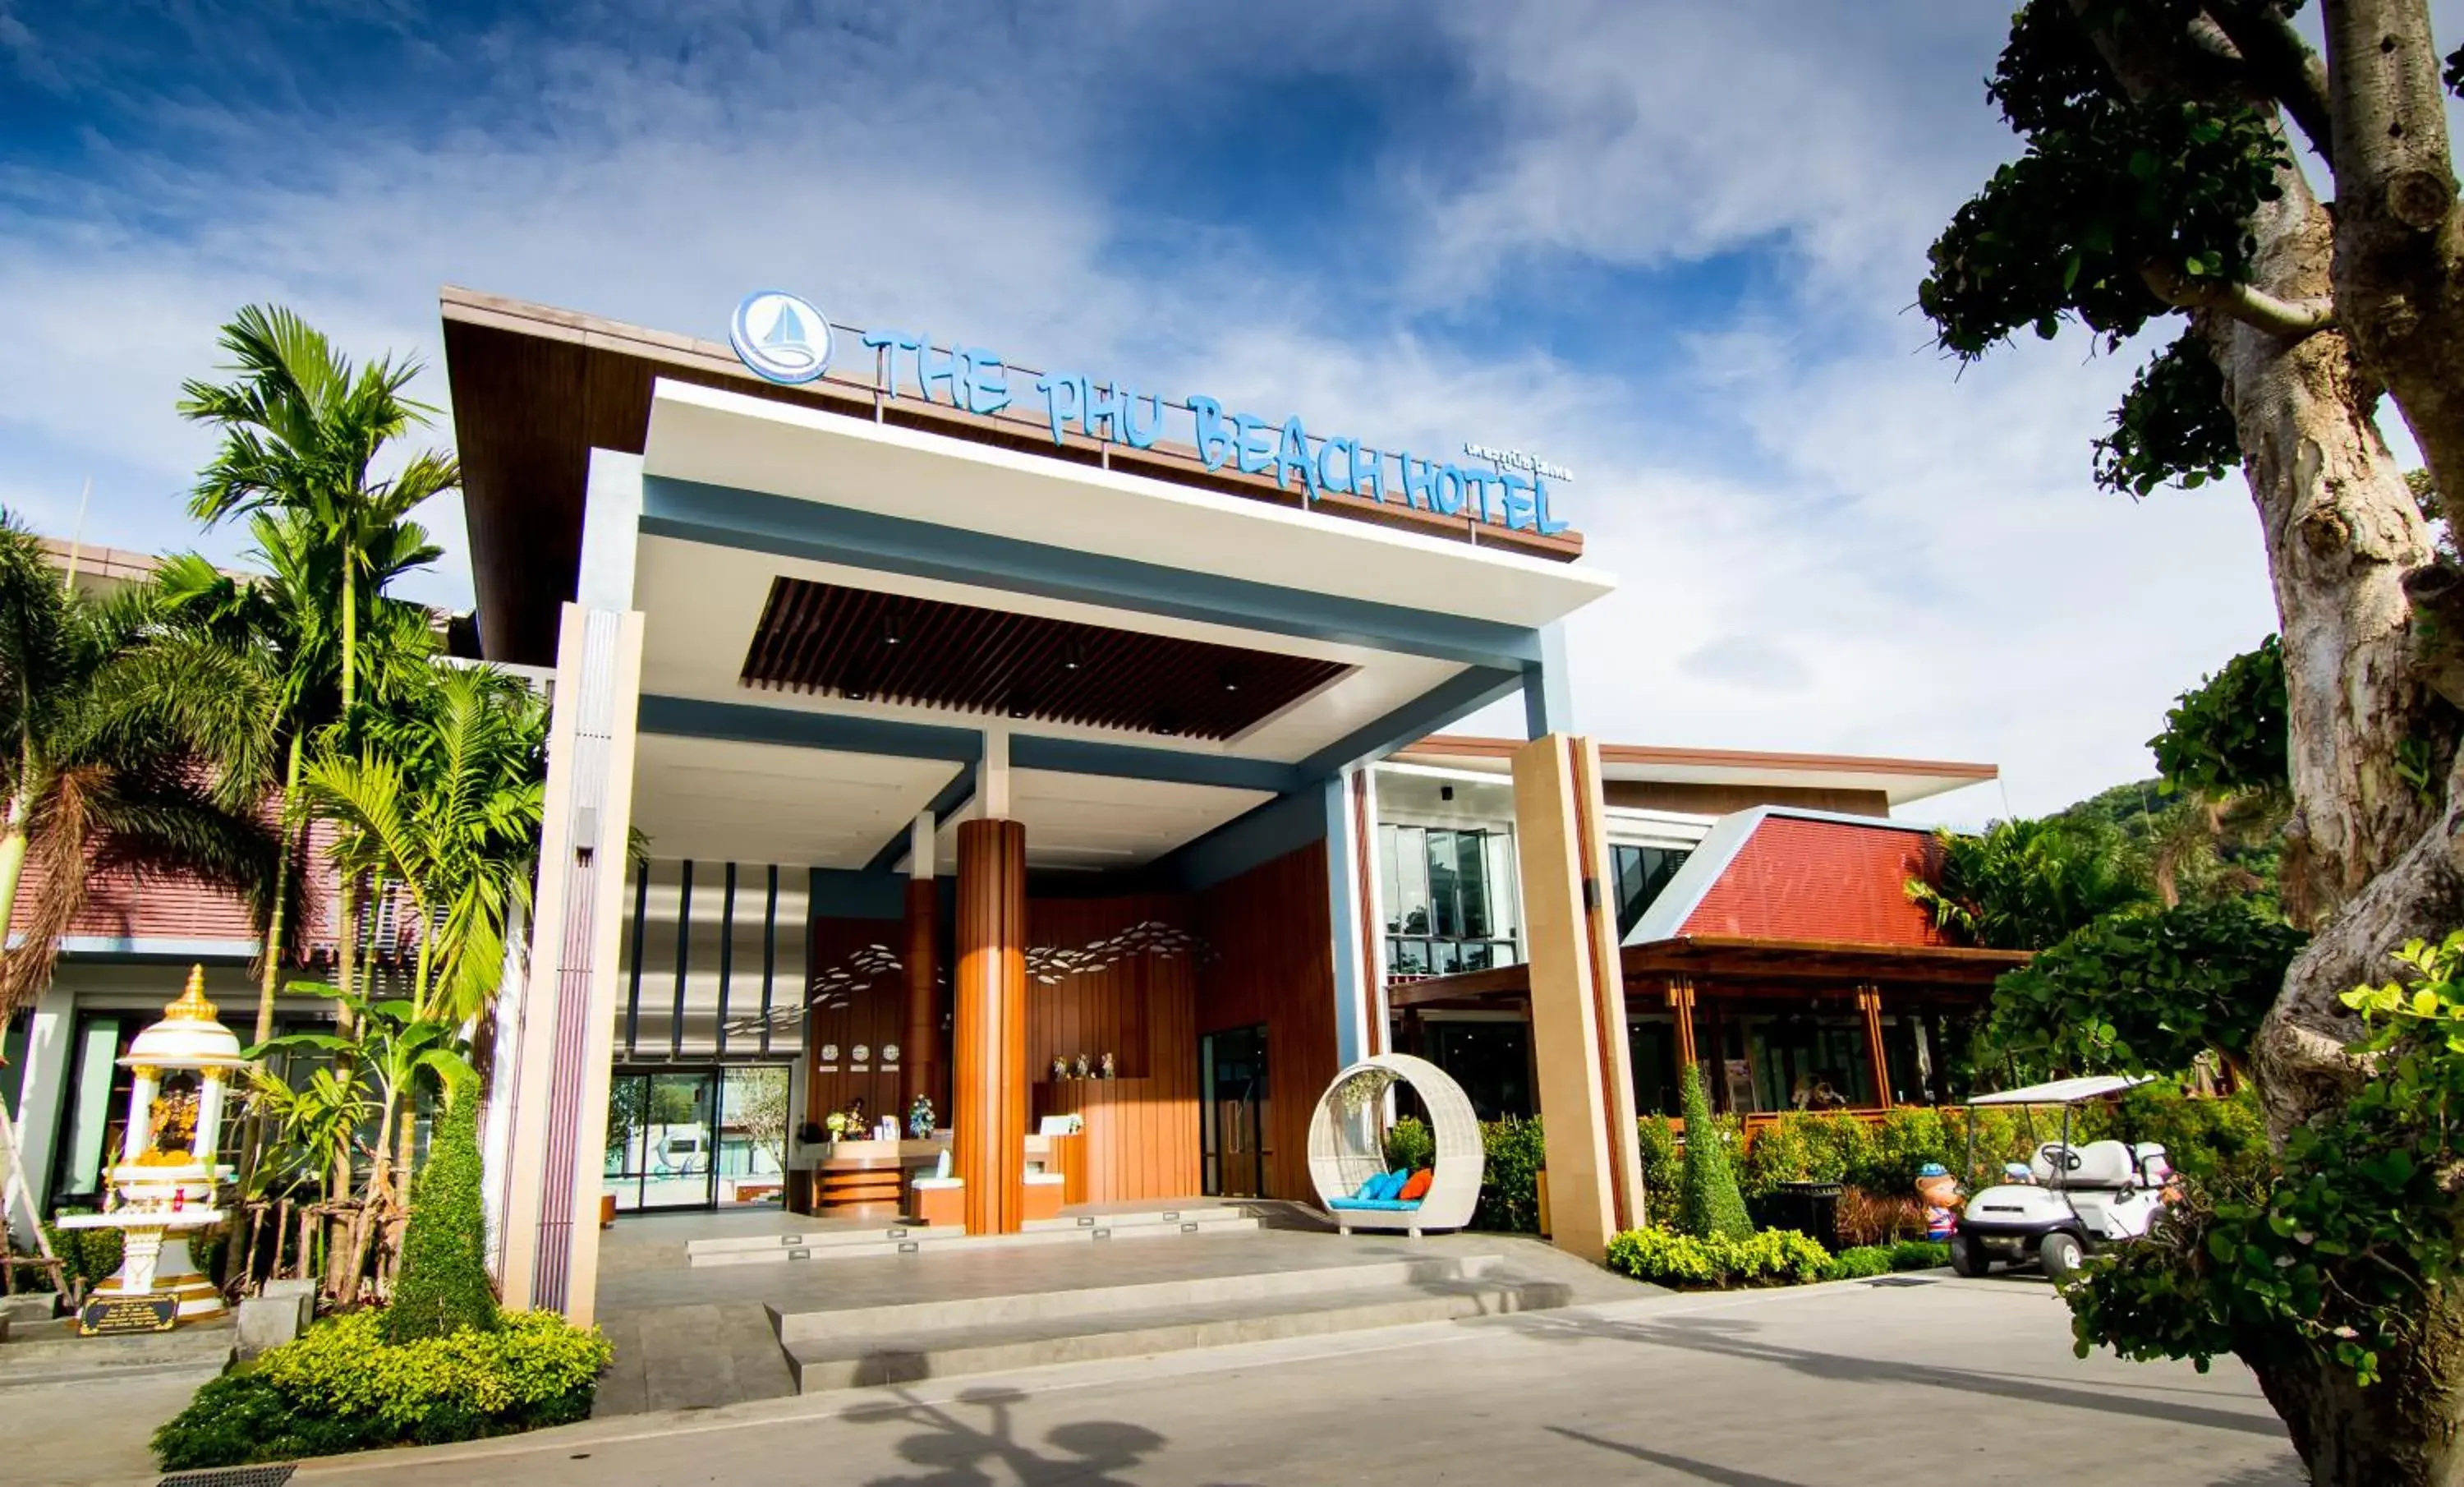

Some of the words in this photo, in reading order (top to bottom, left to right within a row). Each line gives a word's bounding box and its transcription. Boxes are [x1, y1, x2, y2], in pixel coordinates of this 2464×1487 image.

[862, 330, 1012, 415] THE
[1037, 371, 1162, 449] PHU
[1187, 394, 1385, 504] BEACH
[1400, 450, 1570, 536] HOTEL
